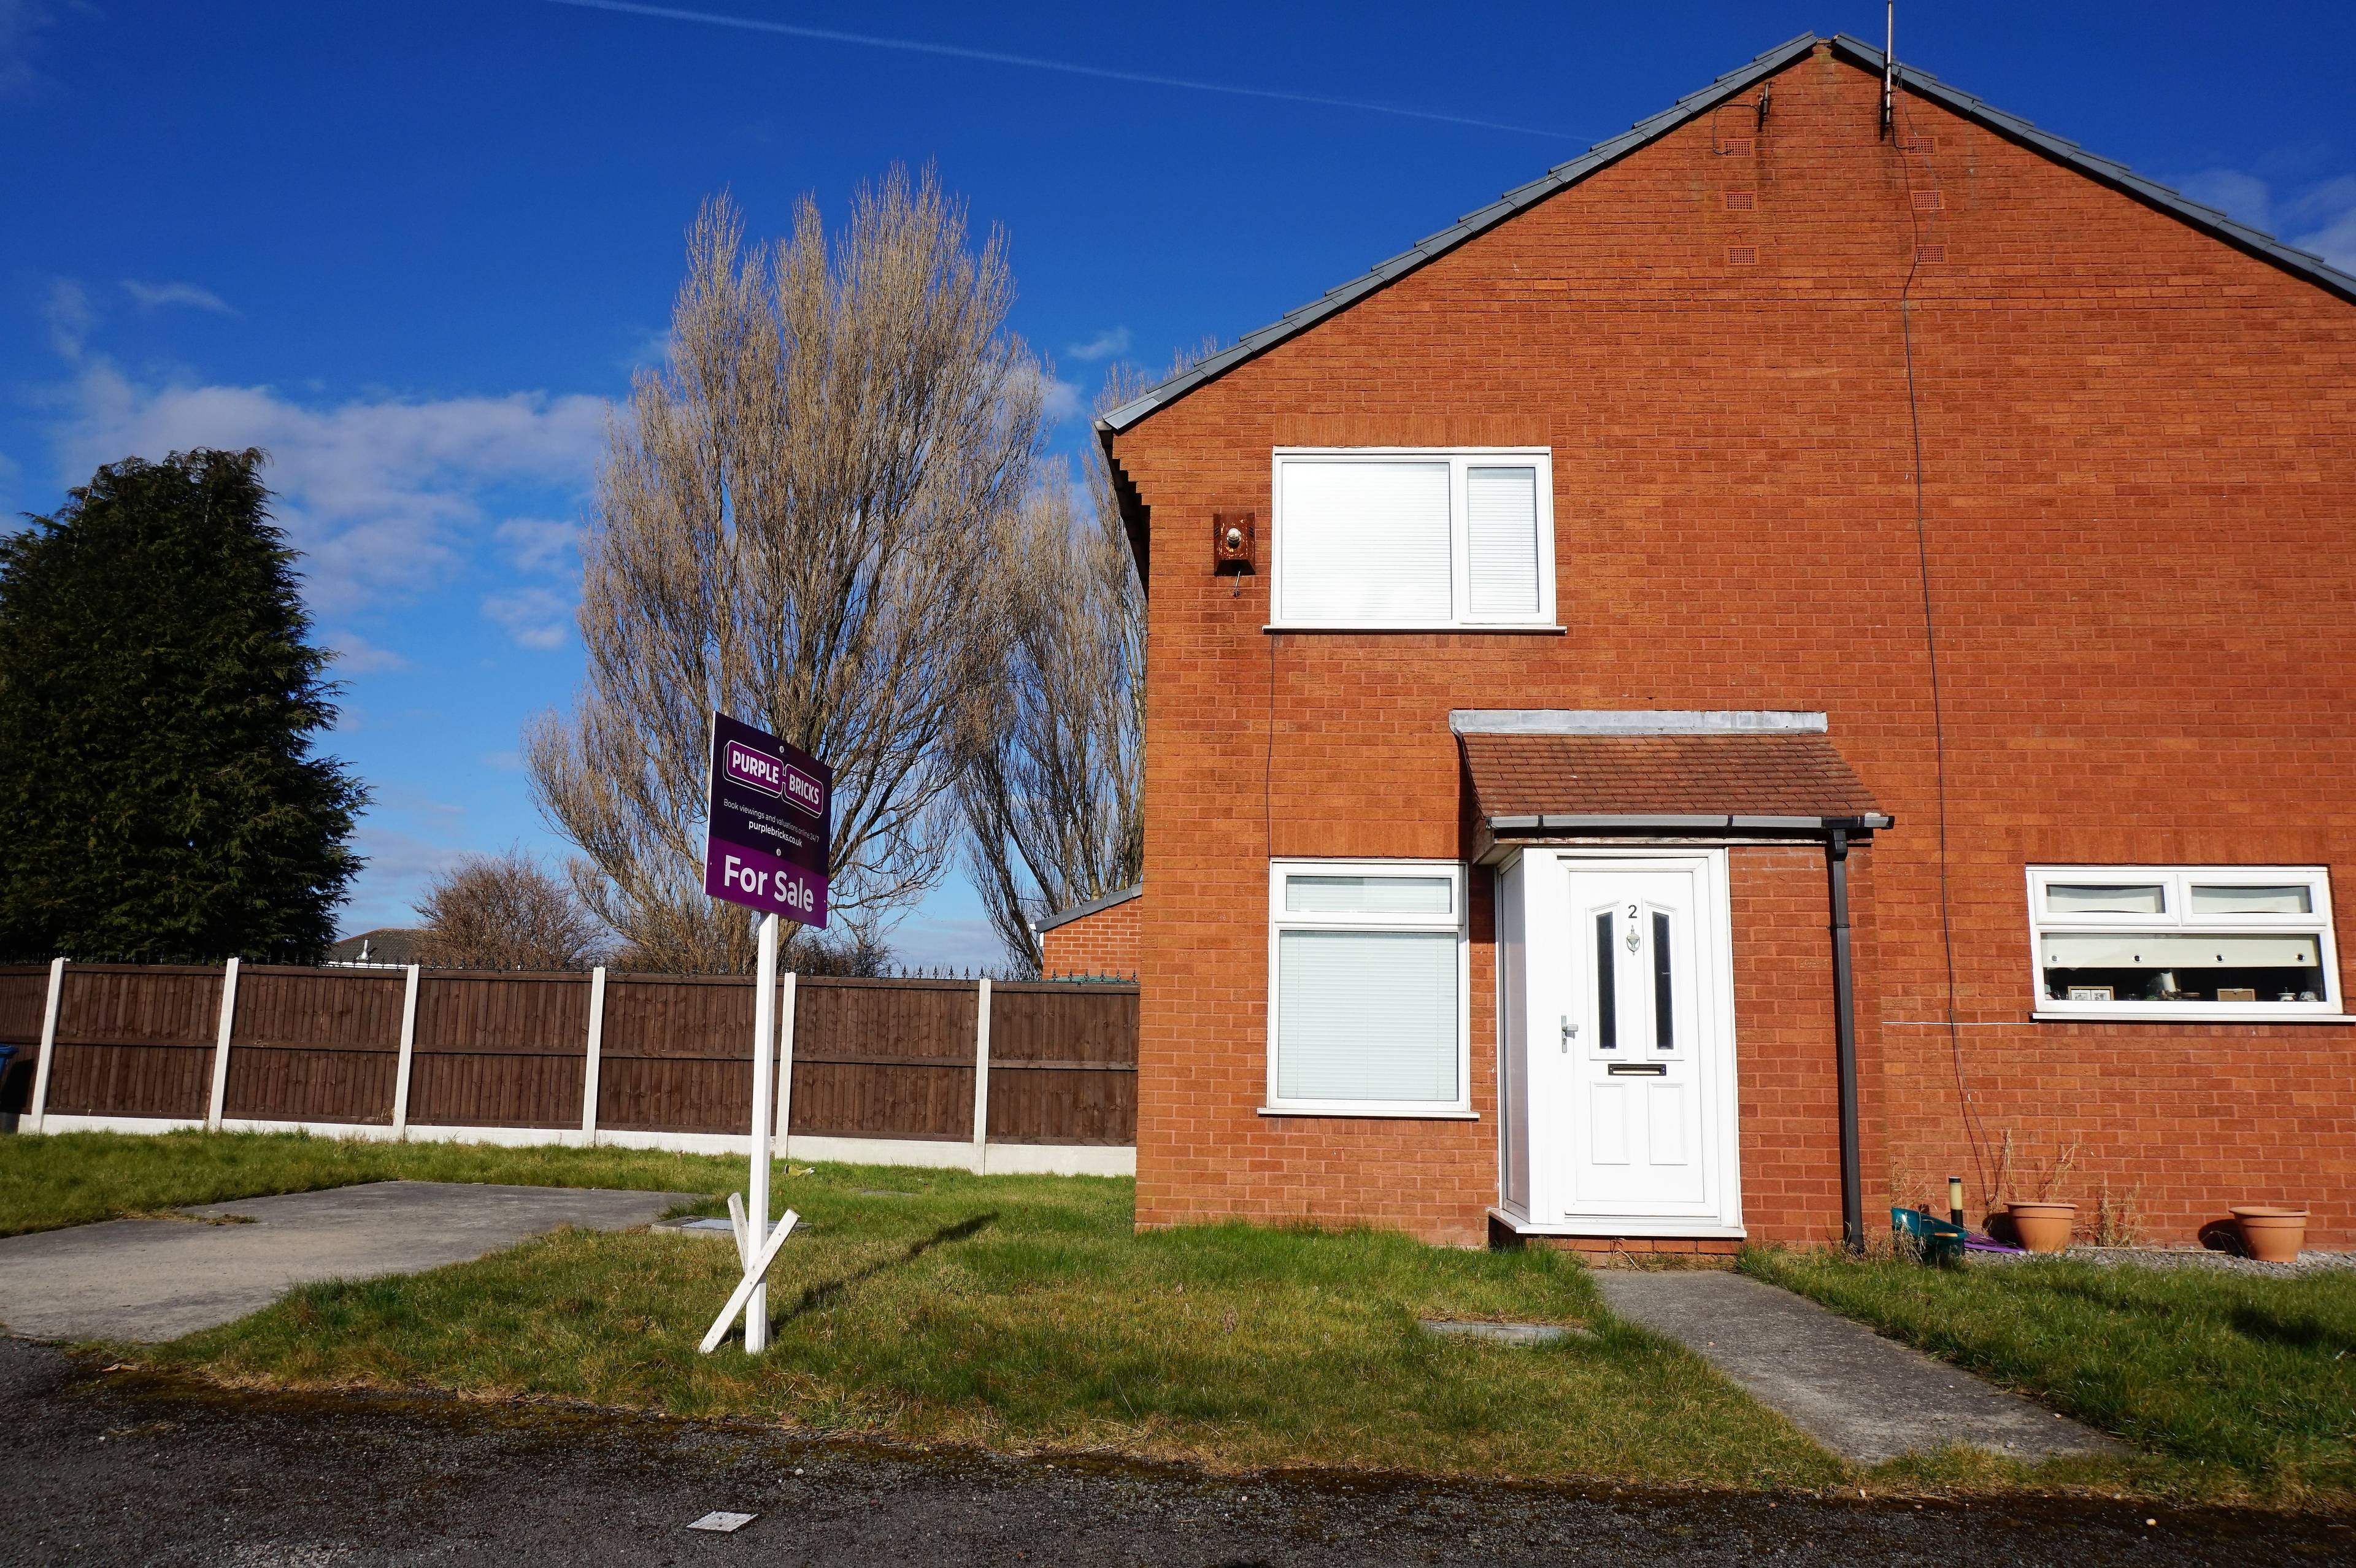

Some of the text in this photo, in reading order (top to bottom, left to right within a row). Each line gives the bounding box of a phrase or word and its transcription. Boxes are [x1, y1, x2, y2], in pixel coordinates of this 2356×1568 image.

[732, 750, 820, 805] PURPLE BRICKS
[723, 798, 820, 843] Book viewings and valuations online 24/7
[749, 820, 803, 848] purplebricks.co.uk
[724, 855, 814, 913] For Sale
[1628, 904, 1638, 918] 2
